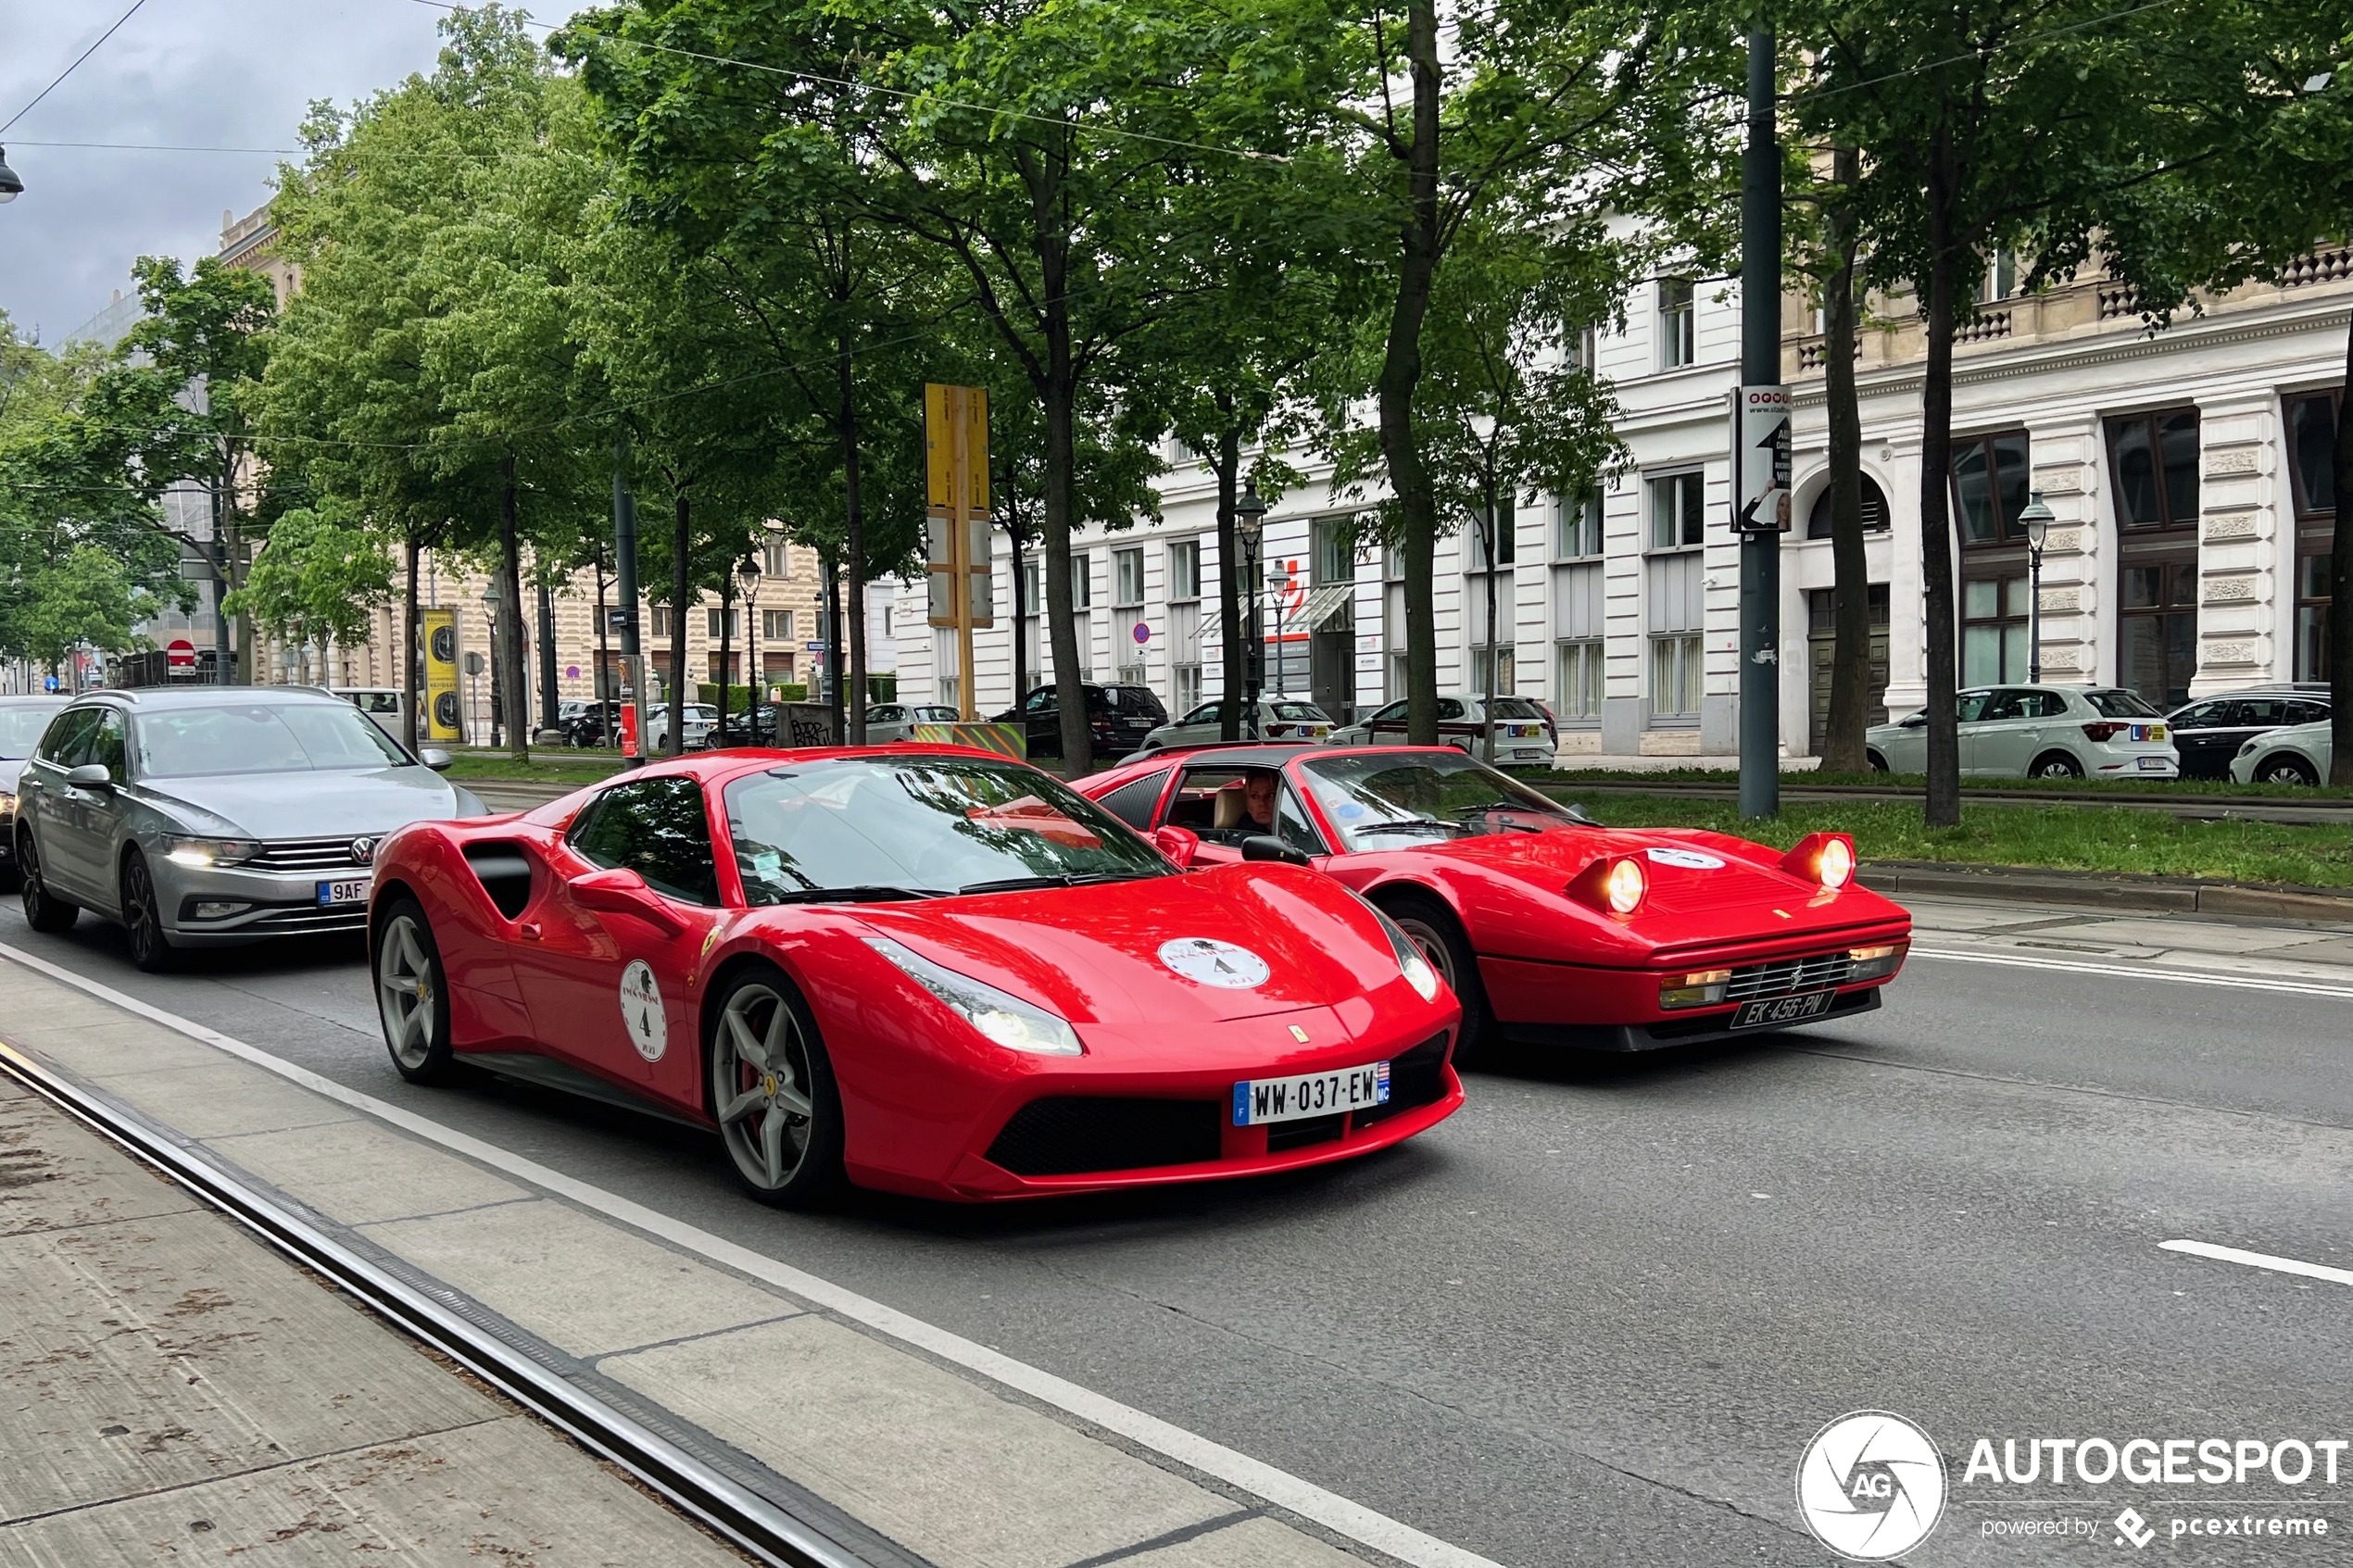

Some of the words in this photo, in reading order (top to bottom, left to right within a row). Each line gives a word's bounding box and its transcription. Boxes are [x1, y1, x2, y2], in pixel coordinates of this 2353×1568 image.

[1509, 725, 1516, 737] L
[2133, 726, 2140, 740] L
[1214, 957, 1238, 974] 4
[1743, 993, 1825, 1024] EK-456-PN
[639, 1006, 651, 1038] 4
[1255, 1070, 1374, 1117] WW-037-EW
[1378, 1087, 1390, 1102] MC
